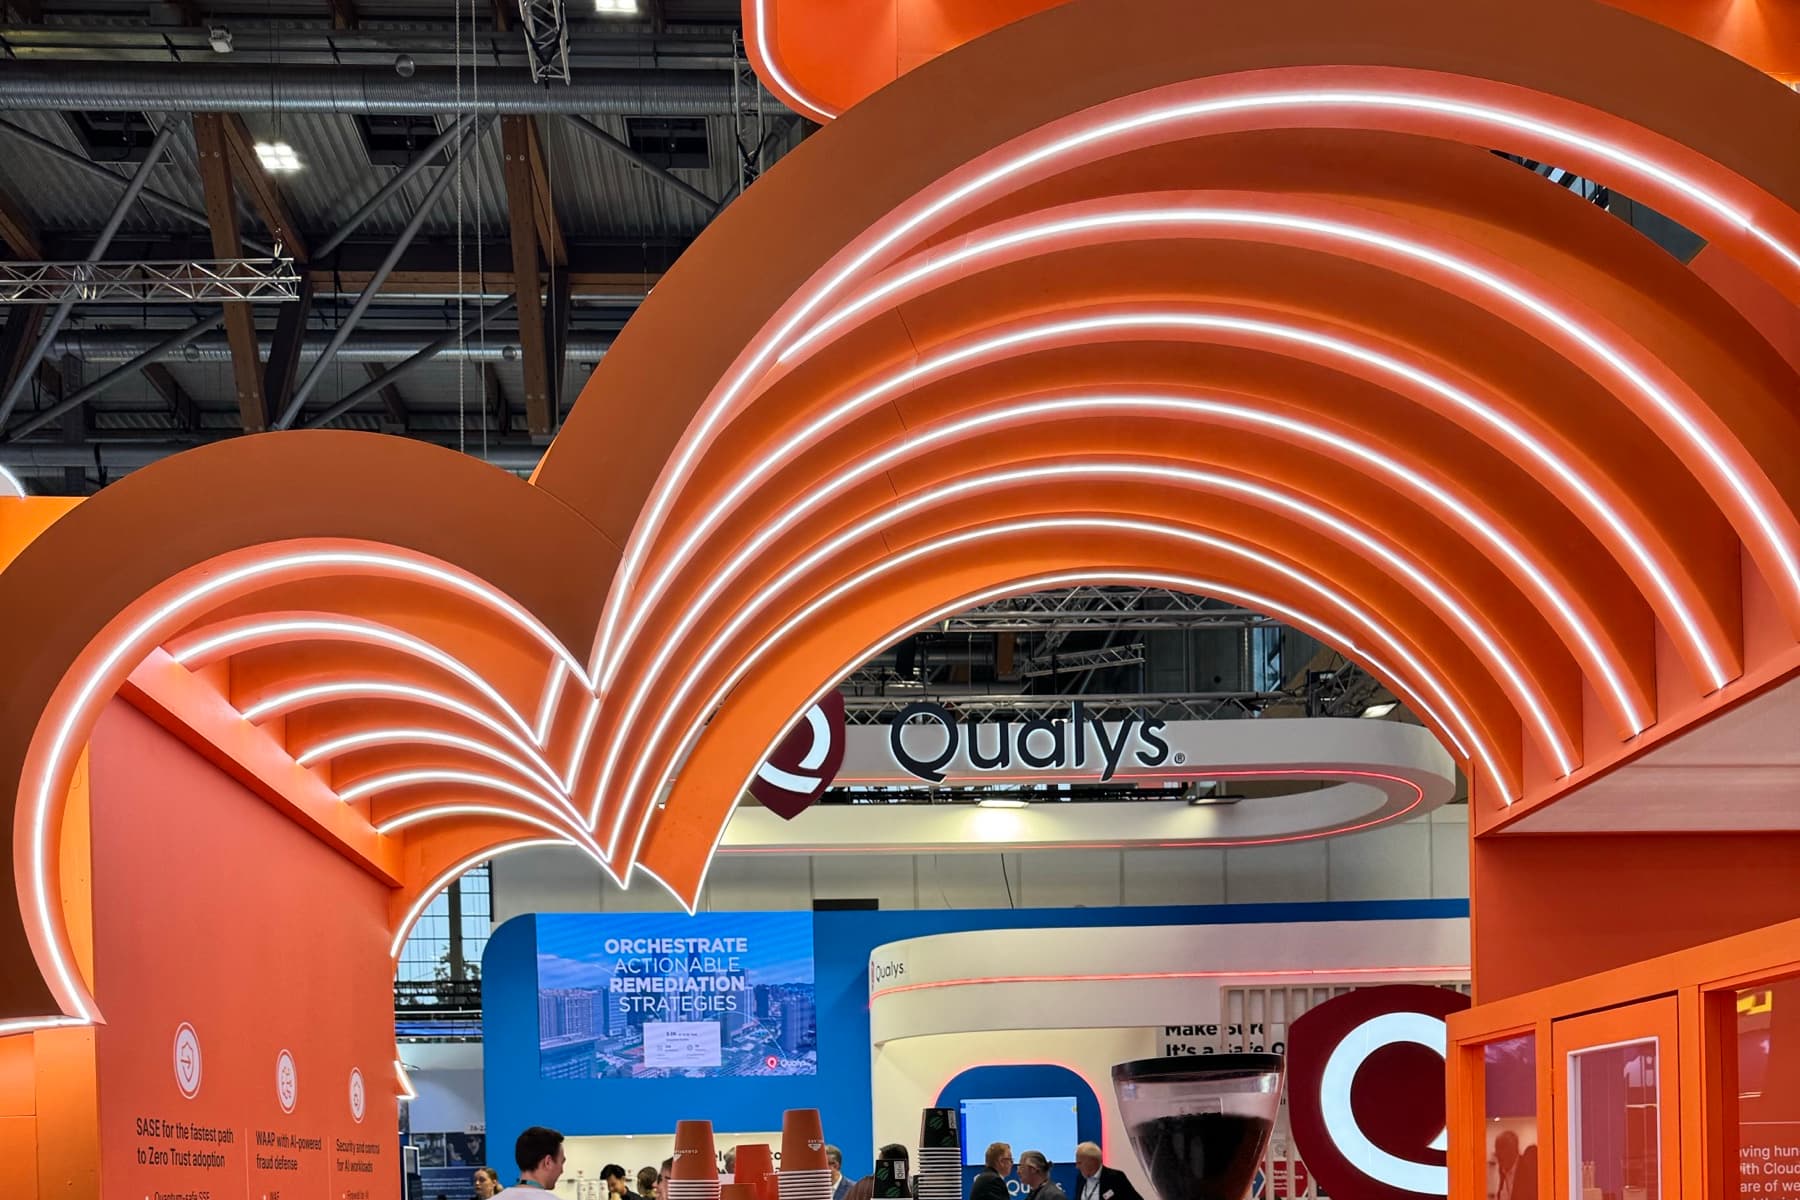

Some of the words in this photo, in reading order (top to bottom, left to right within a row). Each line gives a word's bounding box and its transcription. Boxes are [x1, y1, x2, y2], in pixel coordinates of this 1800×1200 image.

[890, 701, 1169, 782] Qualys
[604, 938, 748, 954] ORCHESTRATE
[614, 956, 741, 974] ACTIONABLE
[876, 961, 904, 982] Qualys
[609, 976, 745, 993] REMEDIATION
[619, 995, 737, 1012] STRATEGIES
[136, 1118, 161, 1137] SASE
[162, 1120, 174, 1139] for
[176, 1122, 189, 1140] the
[190, 1123, 217, 1142] fastest
[218, 1128, 234, 1145] path
[256, 1131, 275, 1146] WAAP
[137, 1147, 147, 1165] to
[148, 1147, 168, 1165] Zero
[170, 1149, 192, 1166] Trust
[193, 1150, 225, 1170] adoption
[256, 1154, 274, 1169] fraud
[275, 1156, 298, 1170] defense
[1764, 1179, 1778, 1192] of
